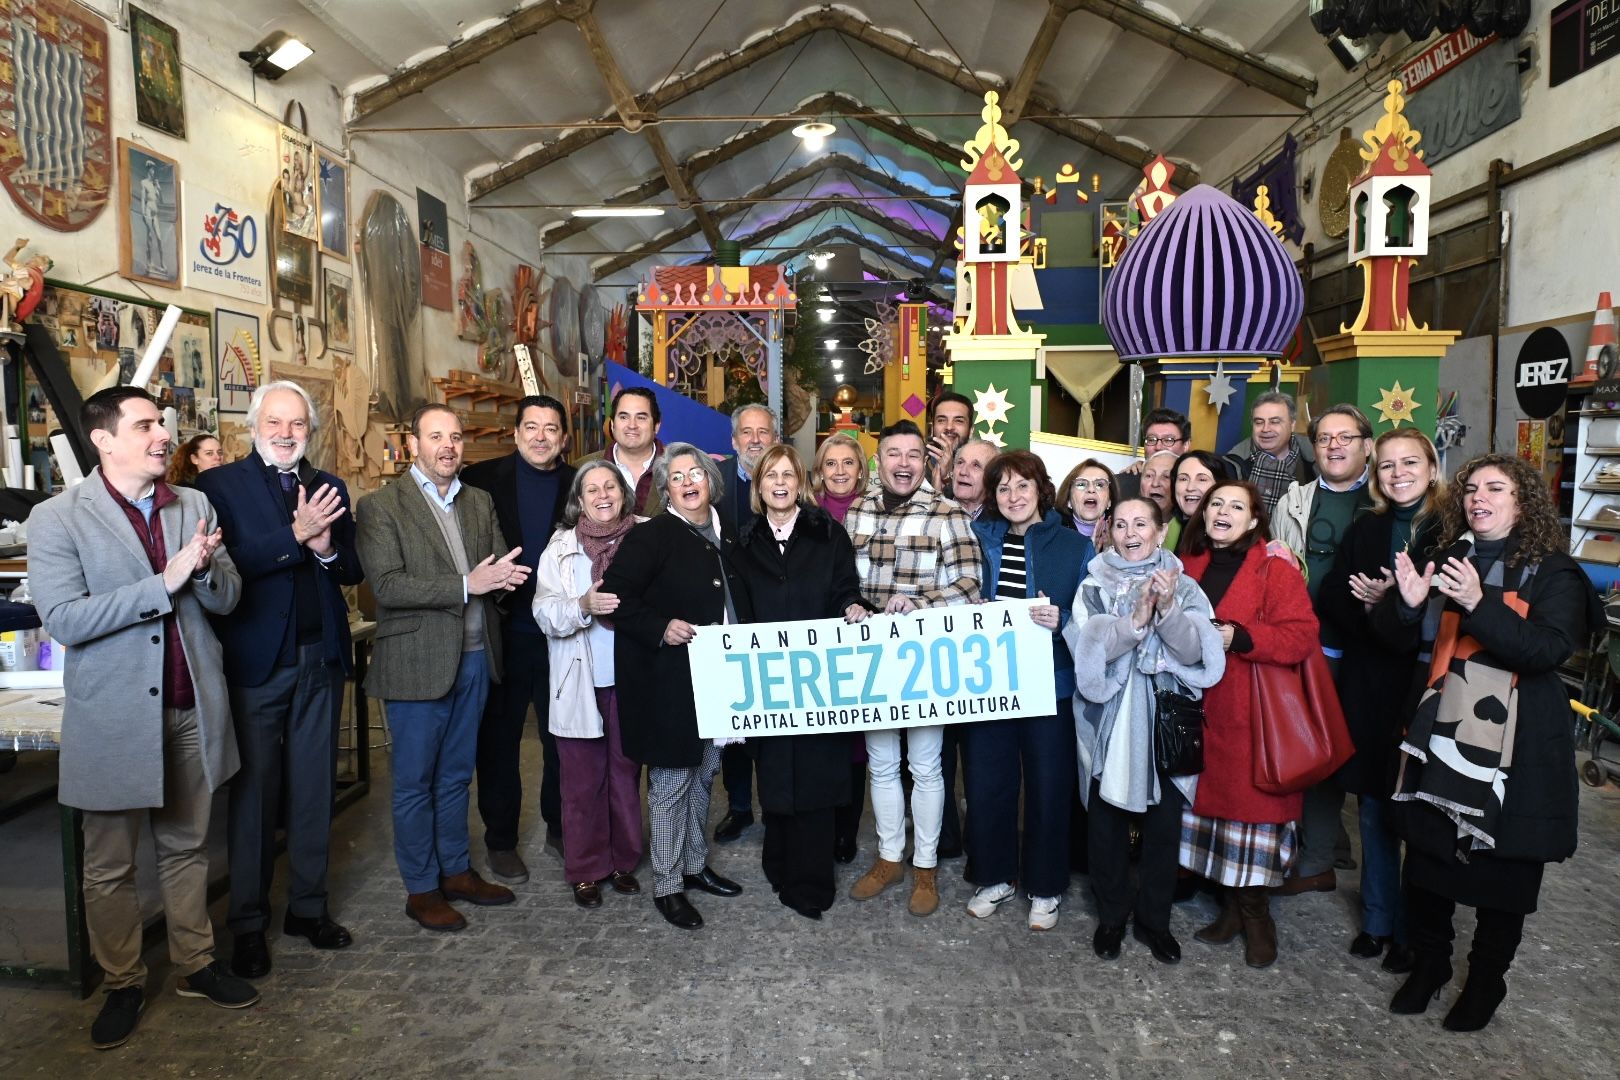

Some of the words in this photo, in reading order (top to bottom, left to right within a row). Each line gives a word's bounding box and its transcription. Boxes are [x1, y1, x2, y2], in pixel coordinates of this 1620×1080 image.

[1402, 53, 1436, 92] FERIA
[1433, 38, 1459, 71] DEL
[199, 202, 257, 266] 750
[193, 261, 213, 274] Jerez
[214, 267, 223, 277] de
[224, 270, 231, 279] la
[232, 271, 262, 287] Frontera
[582, 359, 587, 382] P
[1516, 358, 1569, 388] JEREZ
[721, 609, 1013, 650] CANDIDATURA
[724, 643, 888, 712] JEREZ
[896, 630, 1020, 701] 2031
[731, 711, 799, 731] CAPITAL
[806, 706, 883, 727] EUROPEA
[890, 704, 910, 721] DE
[918, 702, 939, 719] LA
[946, 694, 1021, 716] CULTURA
